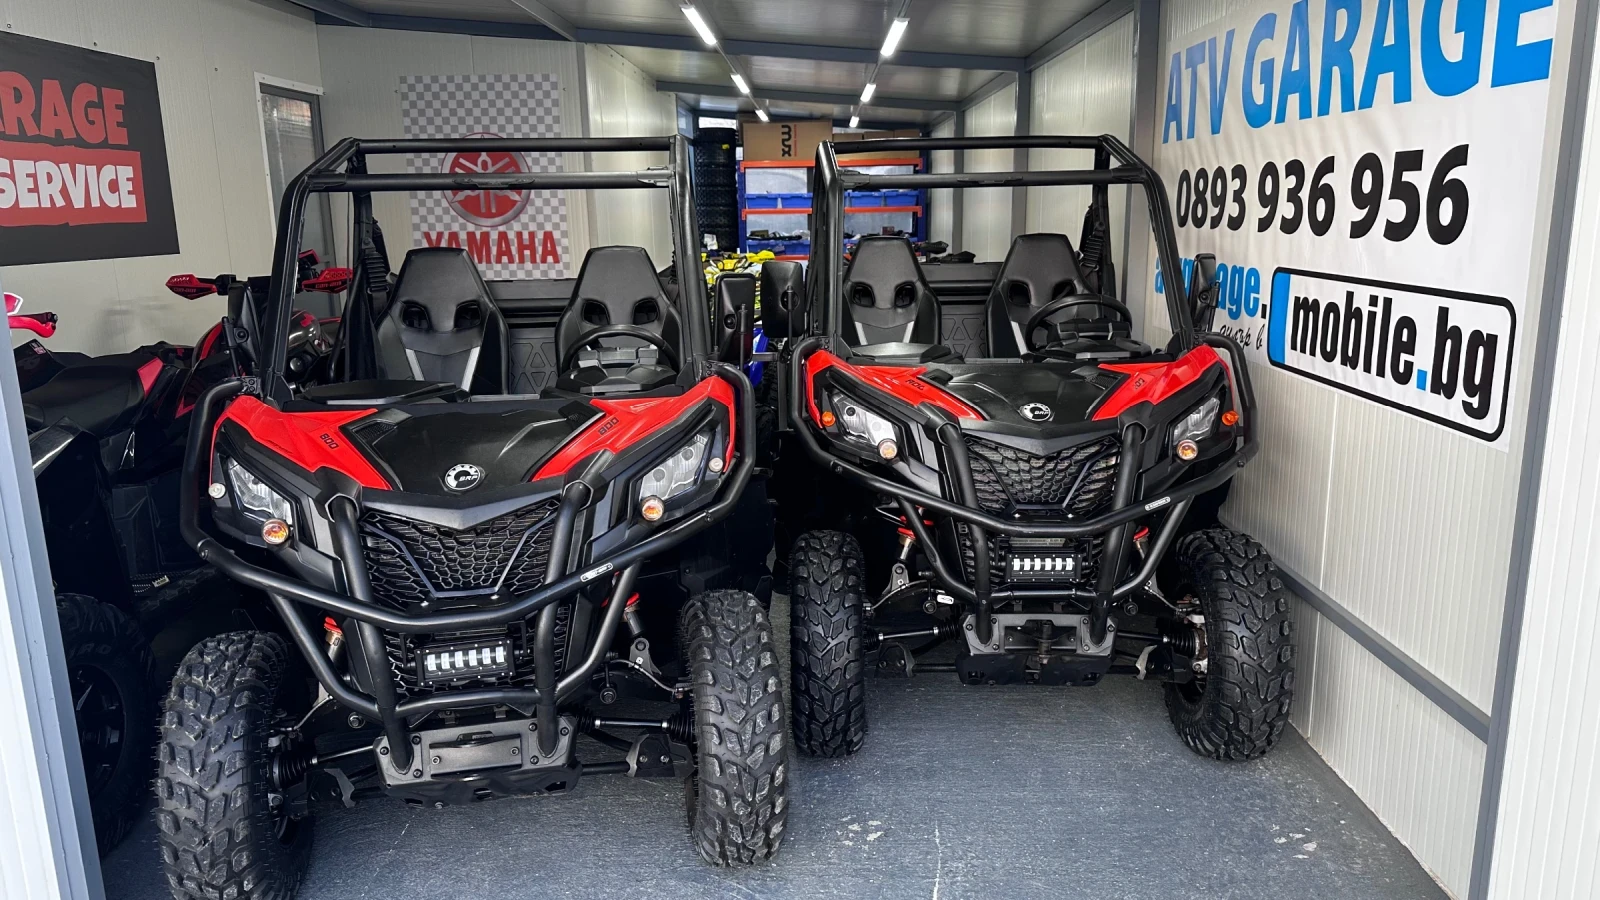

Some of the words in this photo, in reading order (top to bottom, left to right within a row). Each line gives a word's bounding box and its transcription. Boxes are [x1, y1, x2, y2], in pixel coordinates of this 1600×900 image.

[0, 70, 129, 145] RAGE
[1162, 28, 1236, 144] ATV
[1242, 0, 1553, 129] GARAGE
[1176, 164, 1247, 231] 0893
[1257, 155, 1335, 236] 936
[1349, 144, 1469, 245] 956
[1291, 290, 1498, 420] mobile.bg
[320, 433, 339, 449] 800
[598, 416, 619, 435] 800
